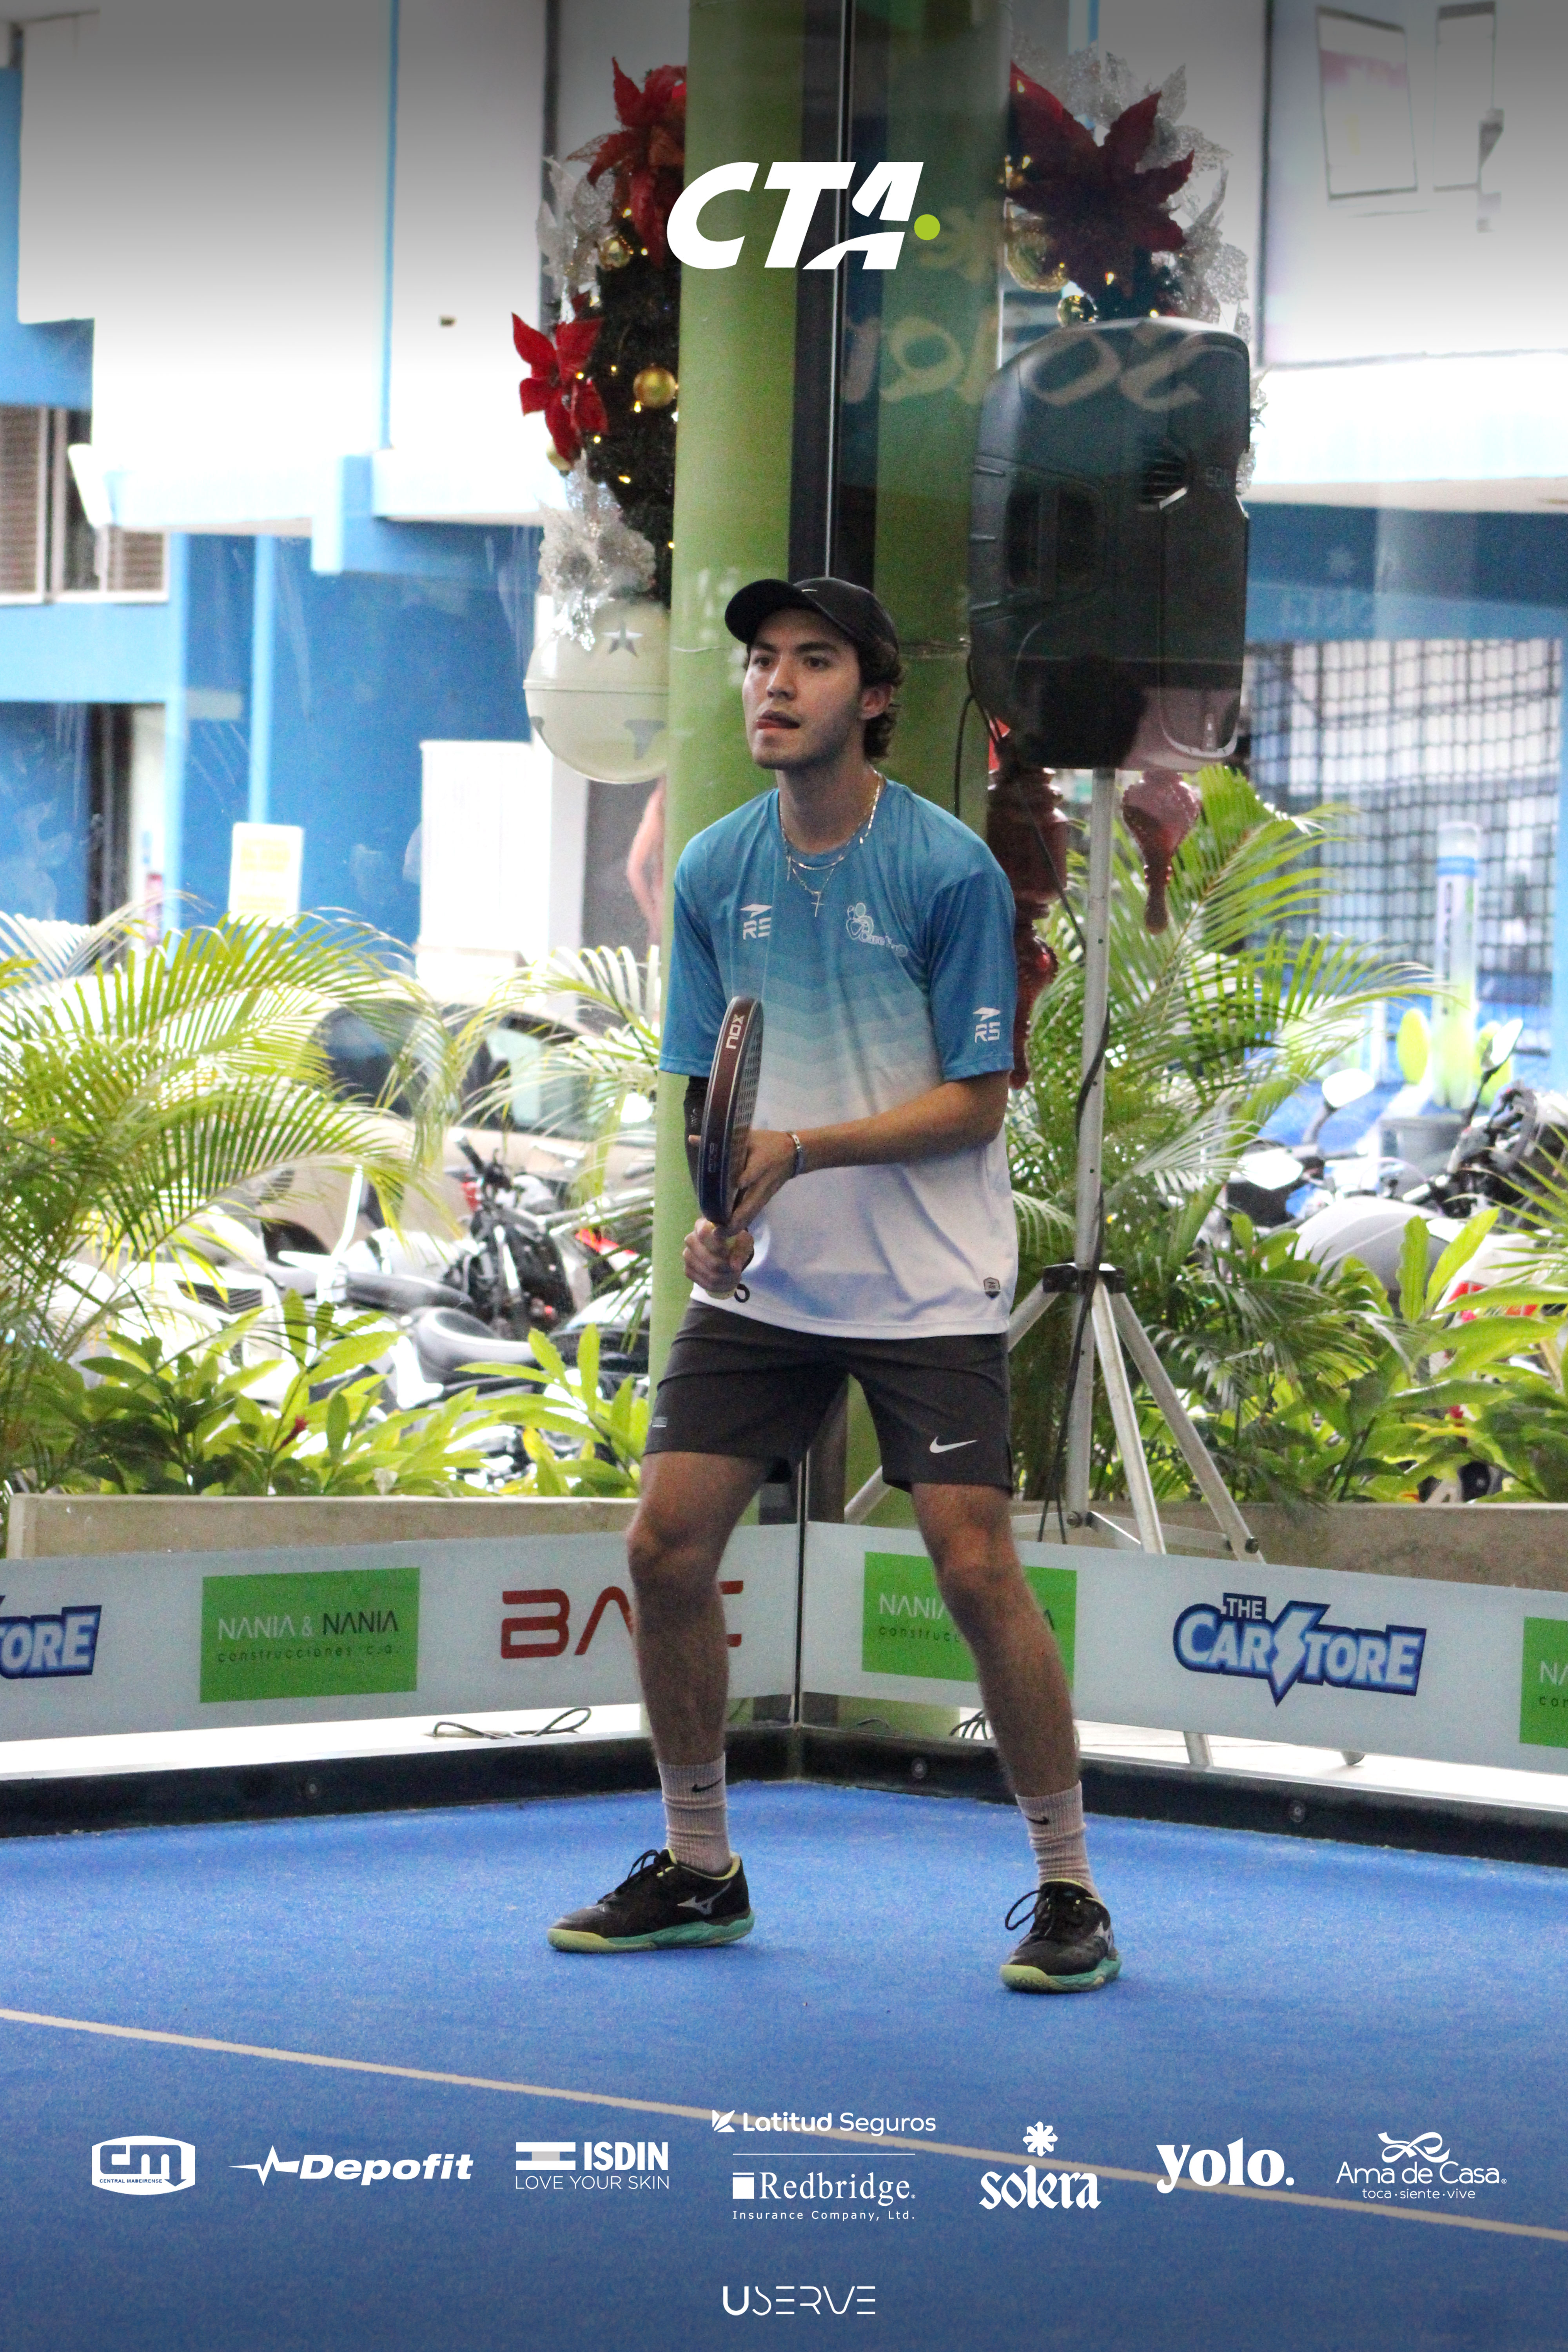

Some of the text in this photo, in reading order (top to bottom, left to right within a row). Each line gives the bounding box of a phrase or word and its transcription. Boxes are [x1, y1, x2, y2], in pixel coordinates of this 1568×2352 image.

[1226, 1597, 1264, 1620] THE
[217, 1610, 399, 1641] NANIA & NANIA
